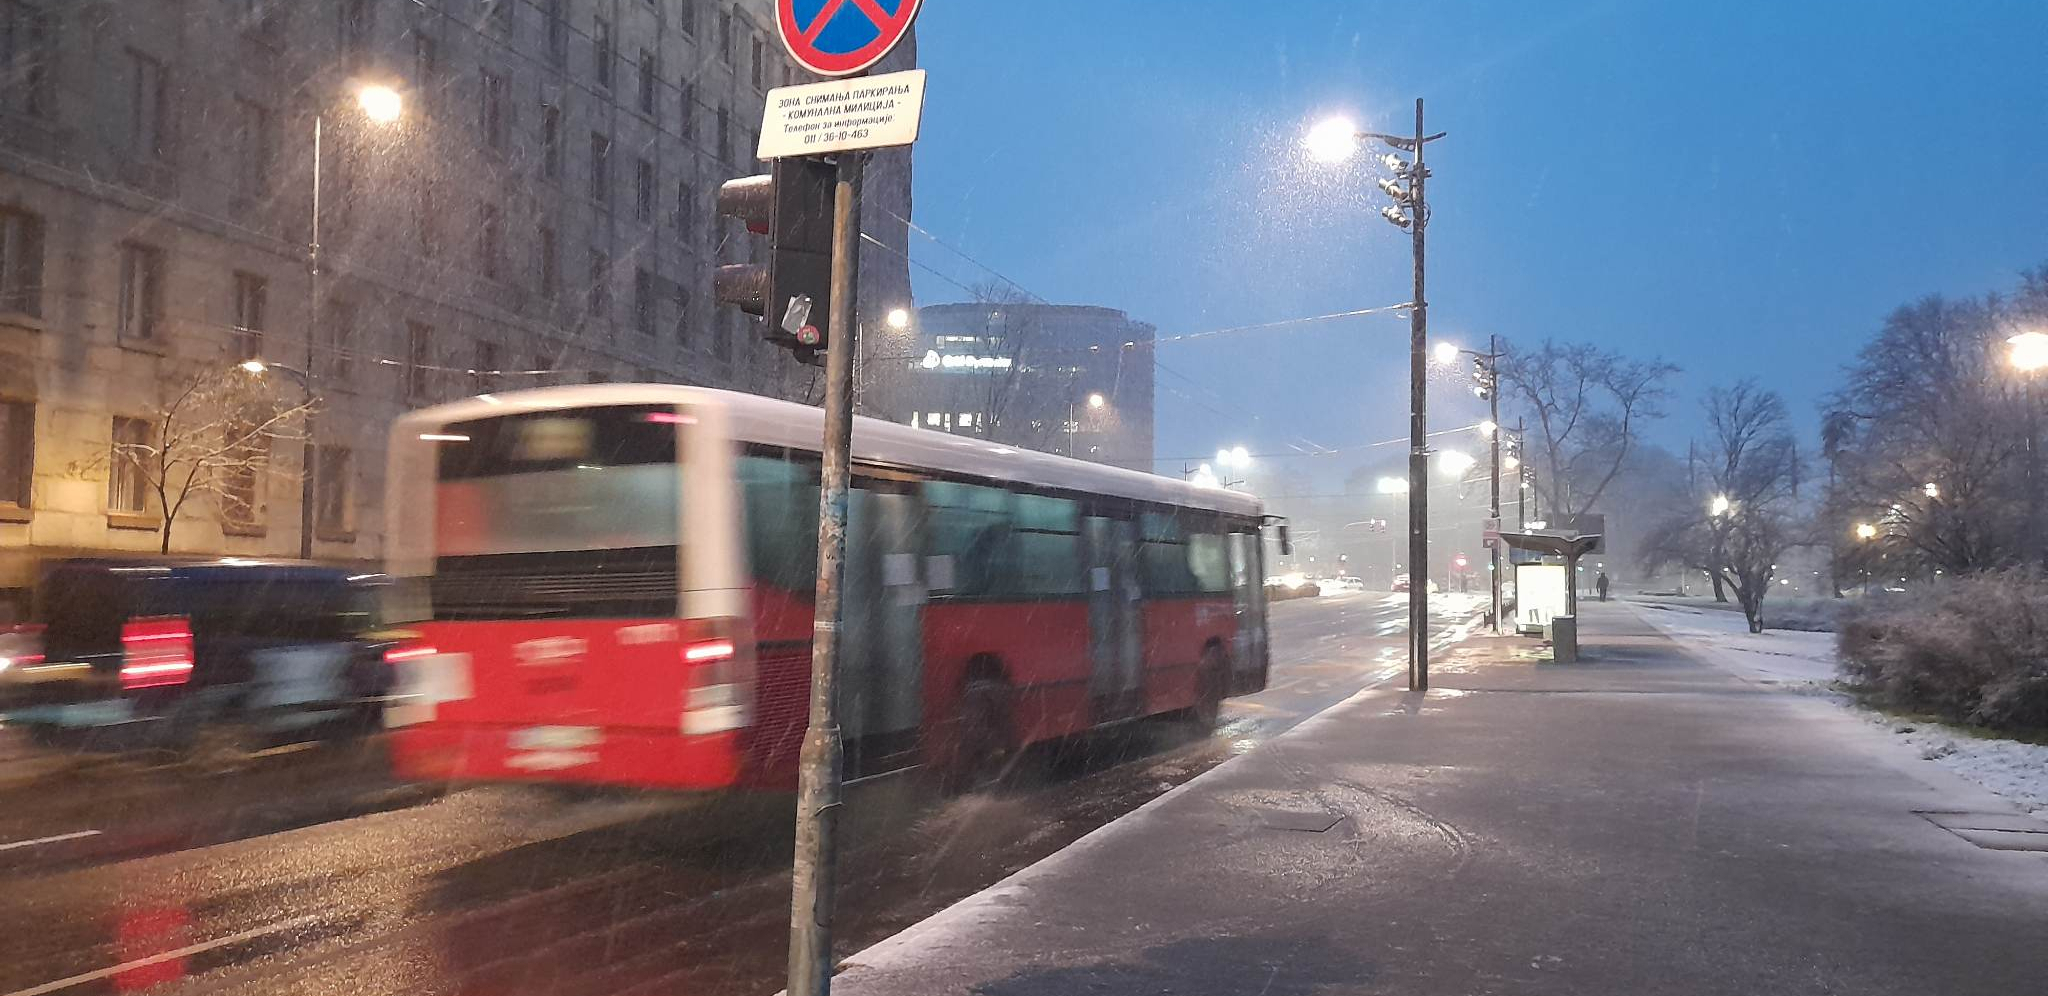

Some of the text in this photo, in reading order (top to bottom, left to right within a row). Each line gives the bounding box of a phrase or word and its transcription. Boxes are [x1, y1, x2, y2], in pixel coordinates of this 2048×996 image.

[778, 84, 910, 108] ЗОНА СНИМАЊА ПАРКИРАЊА
[787, 107, 842, 120] КОМУНАЛНА
[843, 99, 895, 114] МИЛИЦИЈА
[784, 121, 821, 133] Телефон
[822, 119, 832, 129] за
